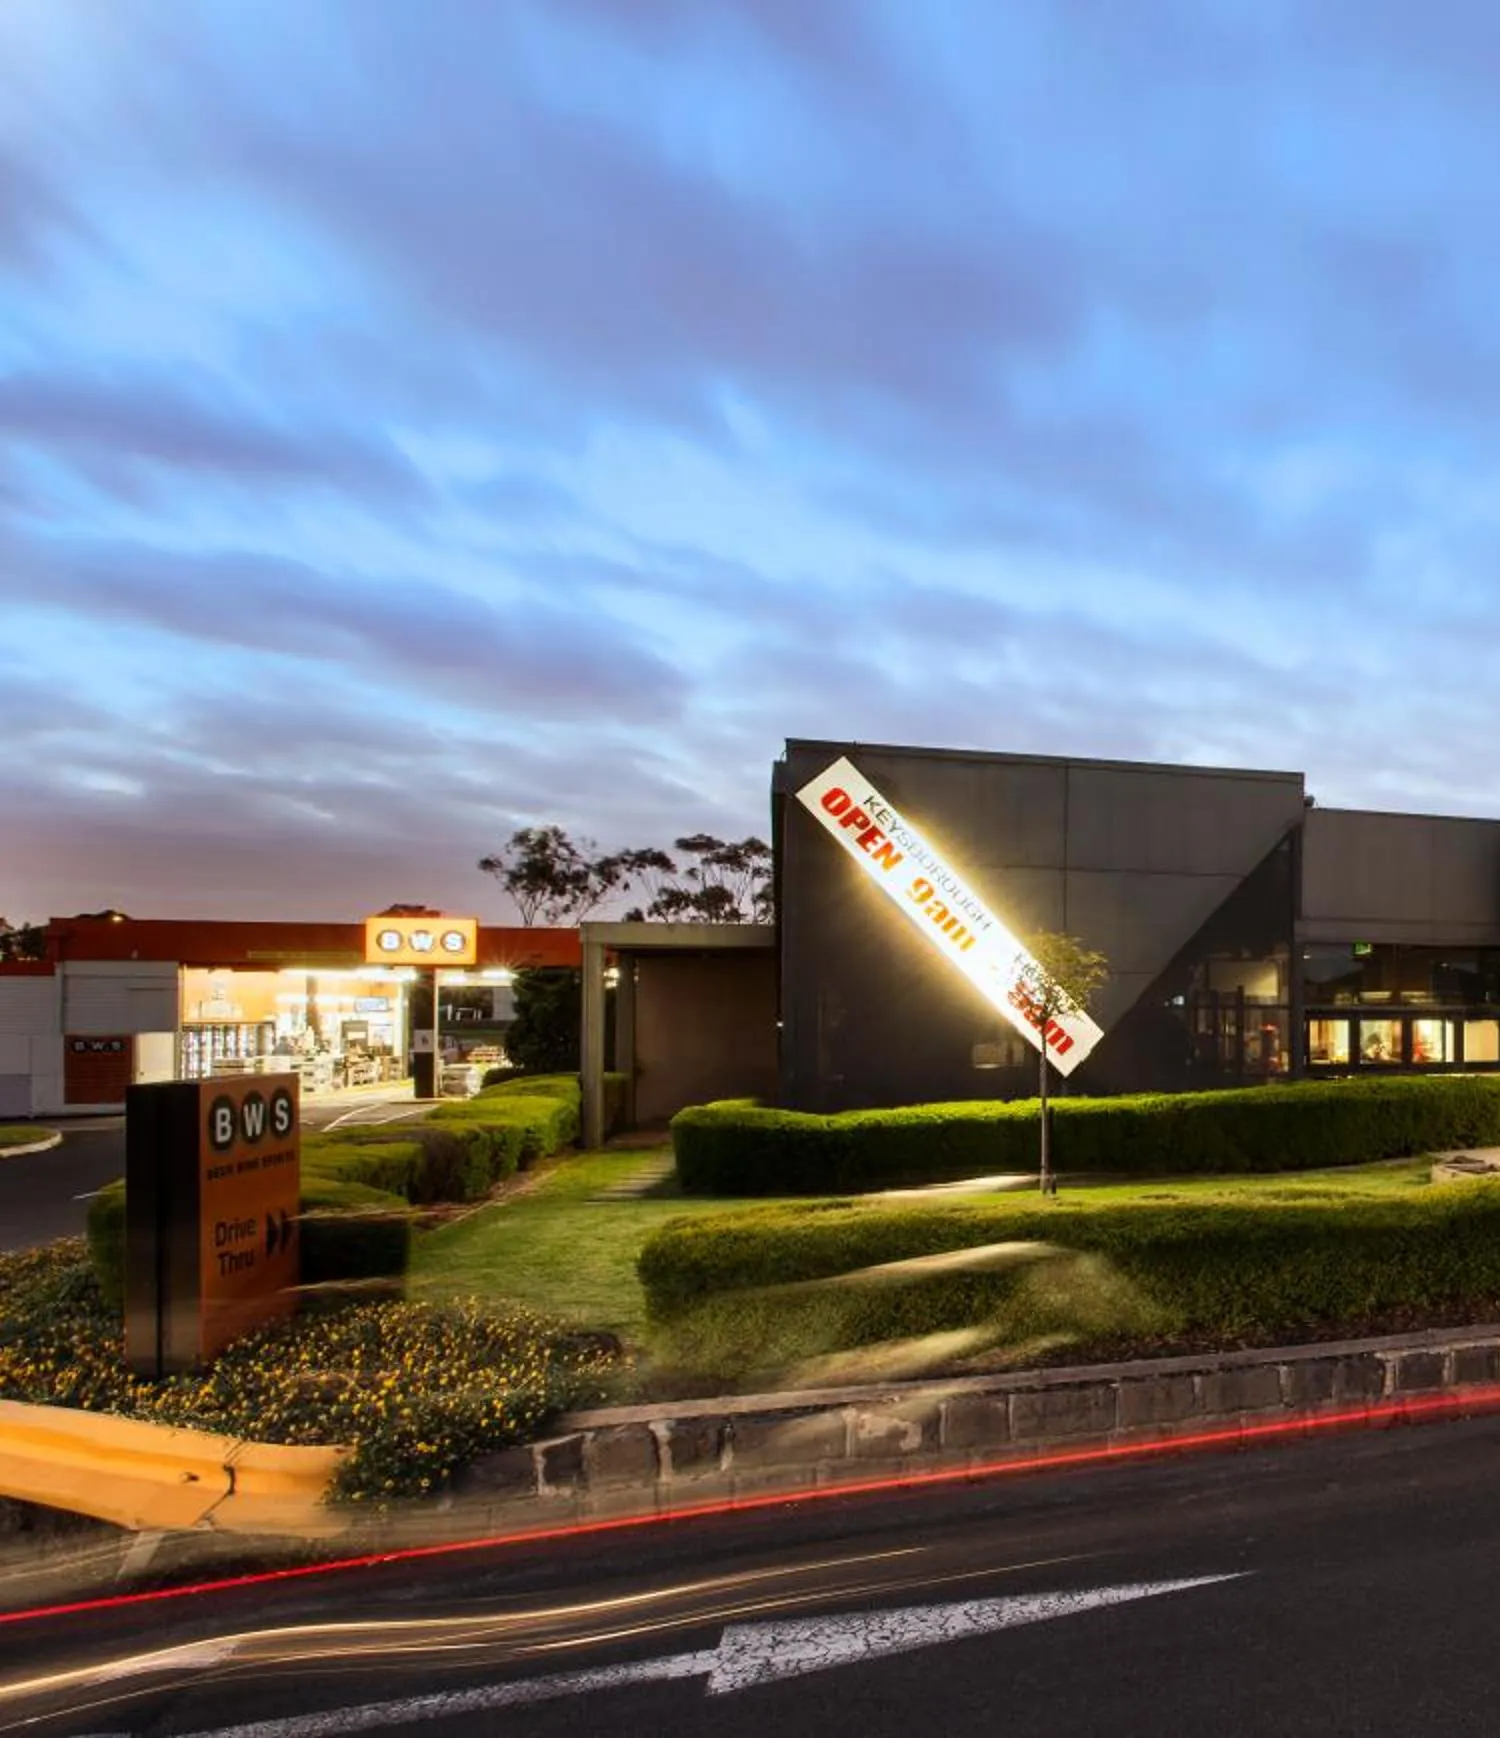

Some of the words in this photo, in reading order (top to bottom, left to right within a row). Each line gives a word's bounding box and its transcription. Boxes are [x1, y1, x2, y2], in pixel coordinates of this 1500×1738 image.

[820, 786, 904, 873] OPEN
[906, 876, 977, 952] 9am
[215, 1097, 289, 1143] BWS
[215, 1216, 257, 1247] Drive
[216, 1249, 255, 1278] Thru
